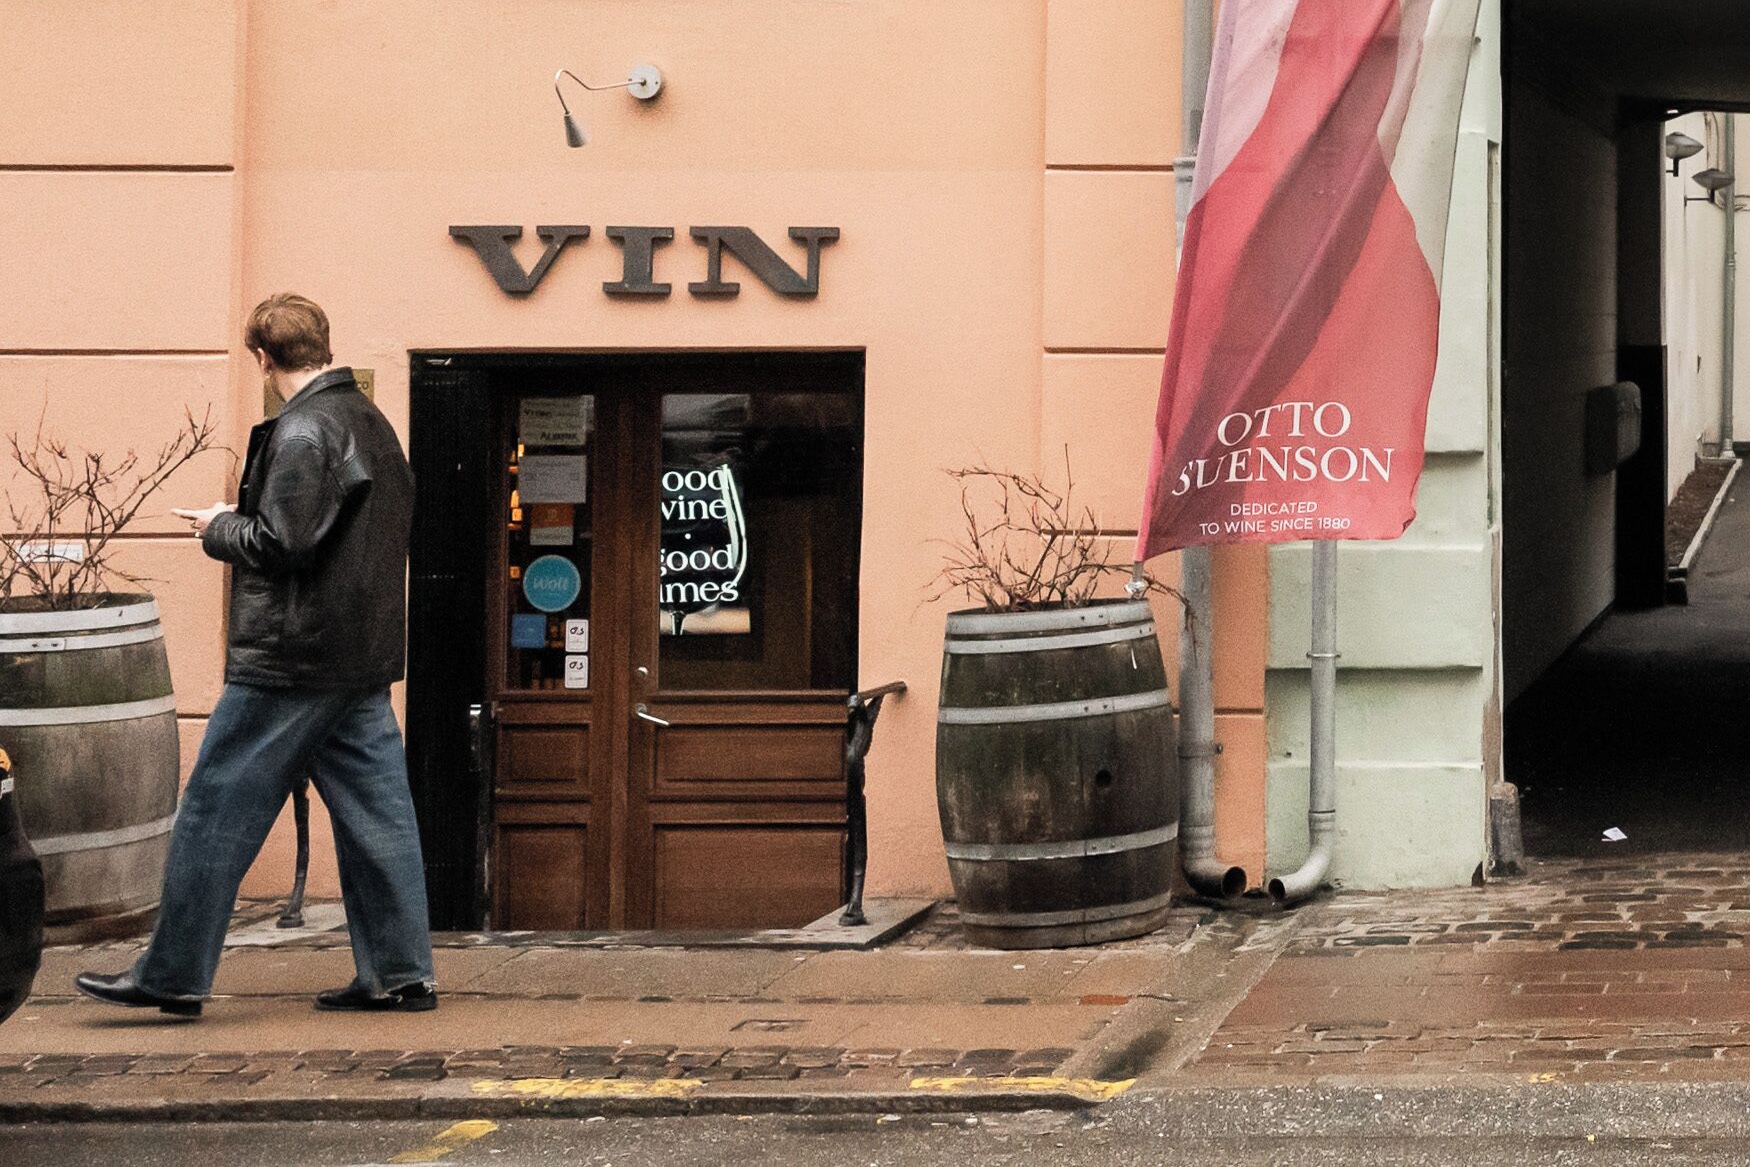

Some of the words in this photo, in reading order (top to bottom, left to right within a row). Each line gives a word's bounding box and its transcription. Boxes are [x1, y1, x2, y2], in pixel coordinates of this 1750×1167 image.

[448, 225, 840, 296] VIN
[1217, 401, 1350, 446] OTTO
[1230, 501, 1317, 516] DEDICATED
[1200, 522, 1219, 535] TO
[1224, 519, 1265, 533] WINE
[1270, 517, 1313, 531] SINCE
[1317, 516, 1350, 530] 1880
